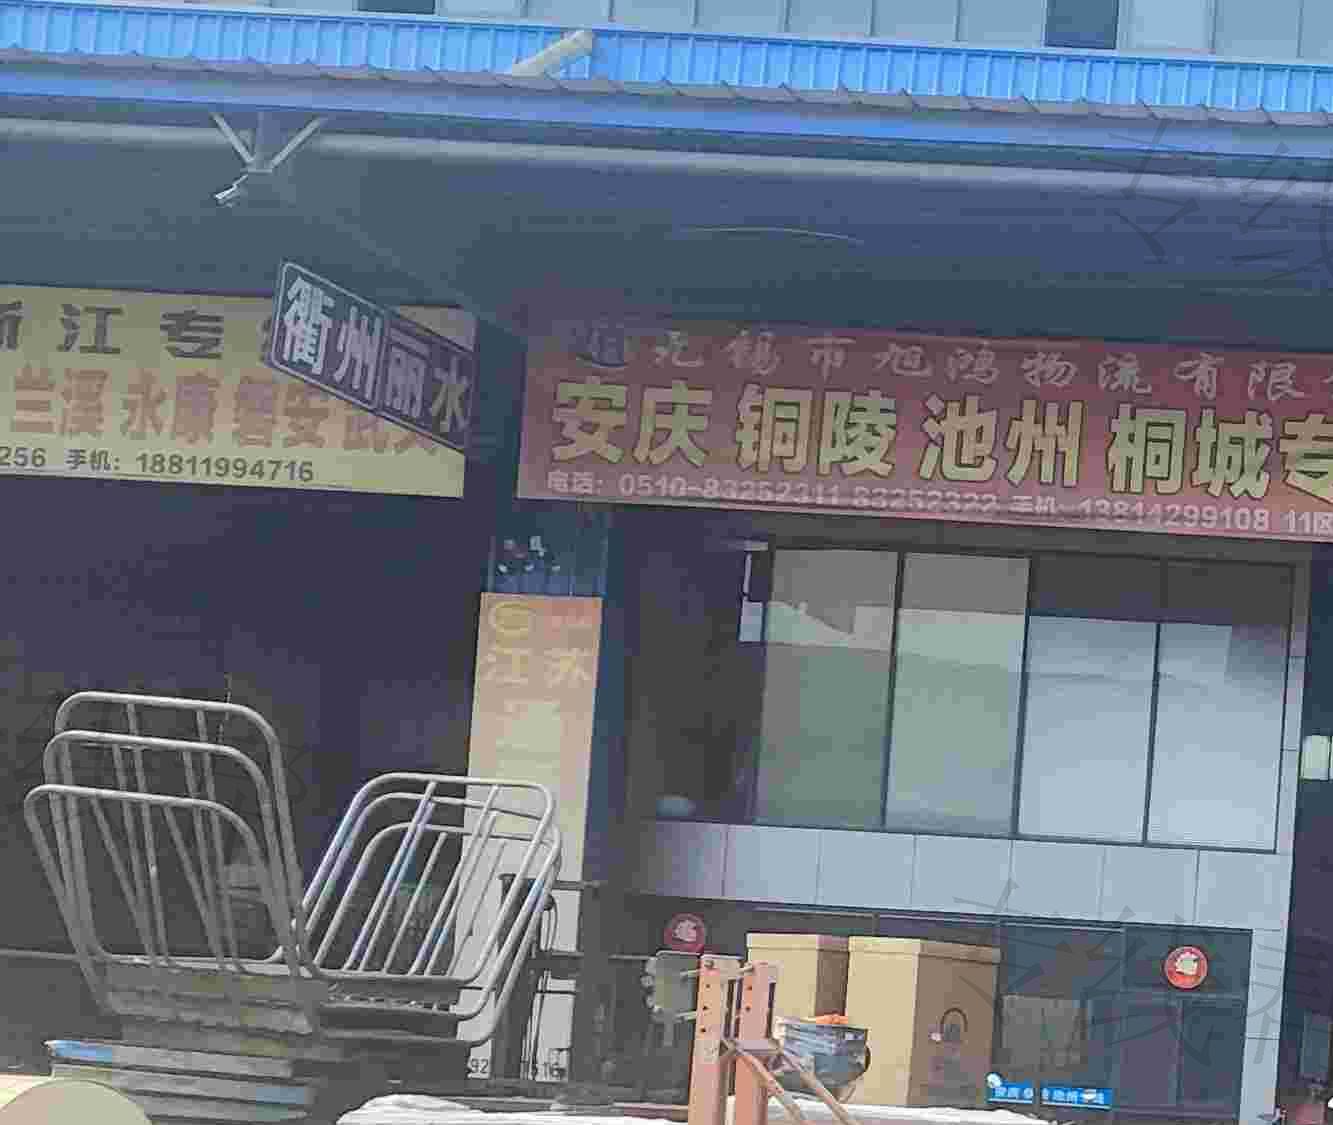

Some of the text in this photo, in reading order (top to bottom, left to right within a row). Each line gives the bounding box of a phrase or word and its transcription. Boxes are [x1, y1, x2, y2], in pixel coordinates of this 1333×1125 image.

[551, 377, 713, 467] 安庆
[735, 383, 898, 480] 铜陵
[918, 393, 1086, 488] 池州
